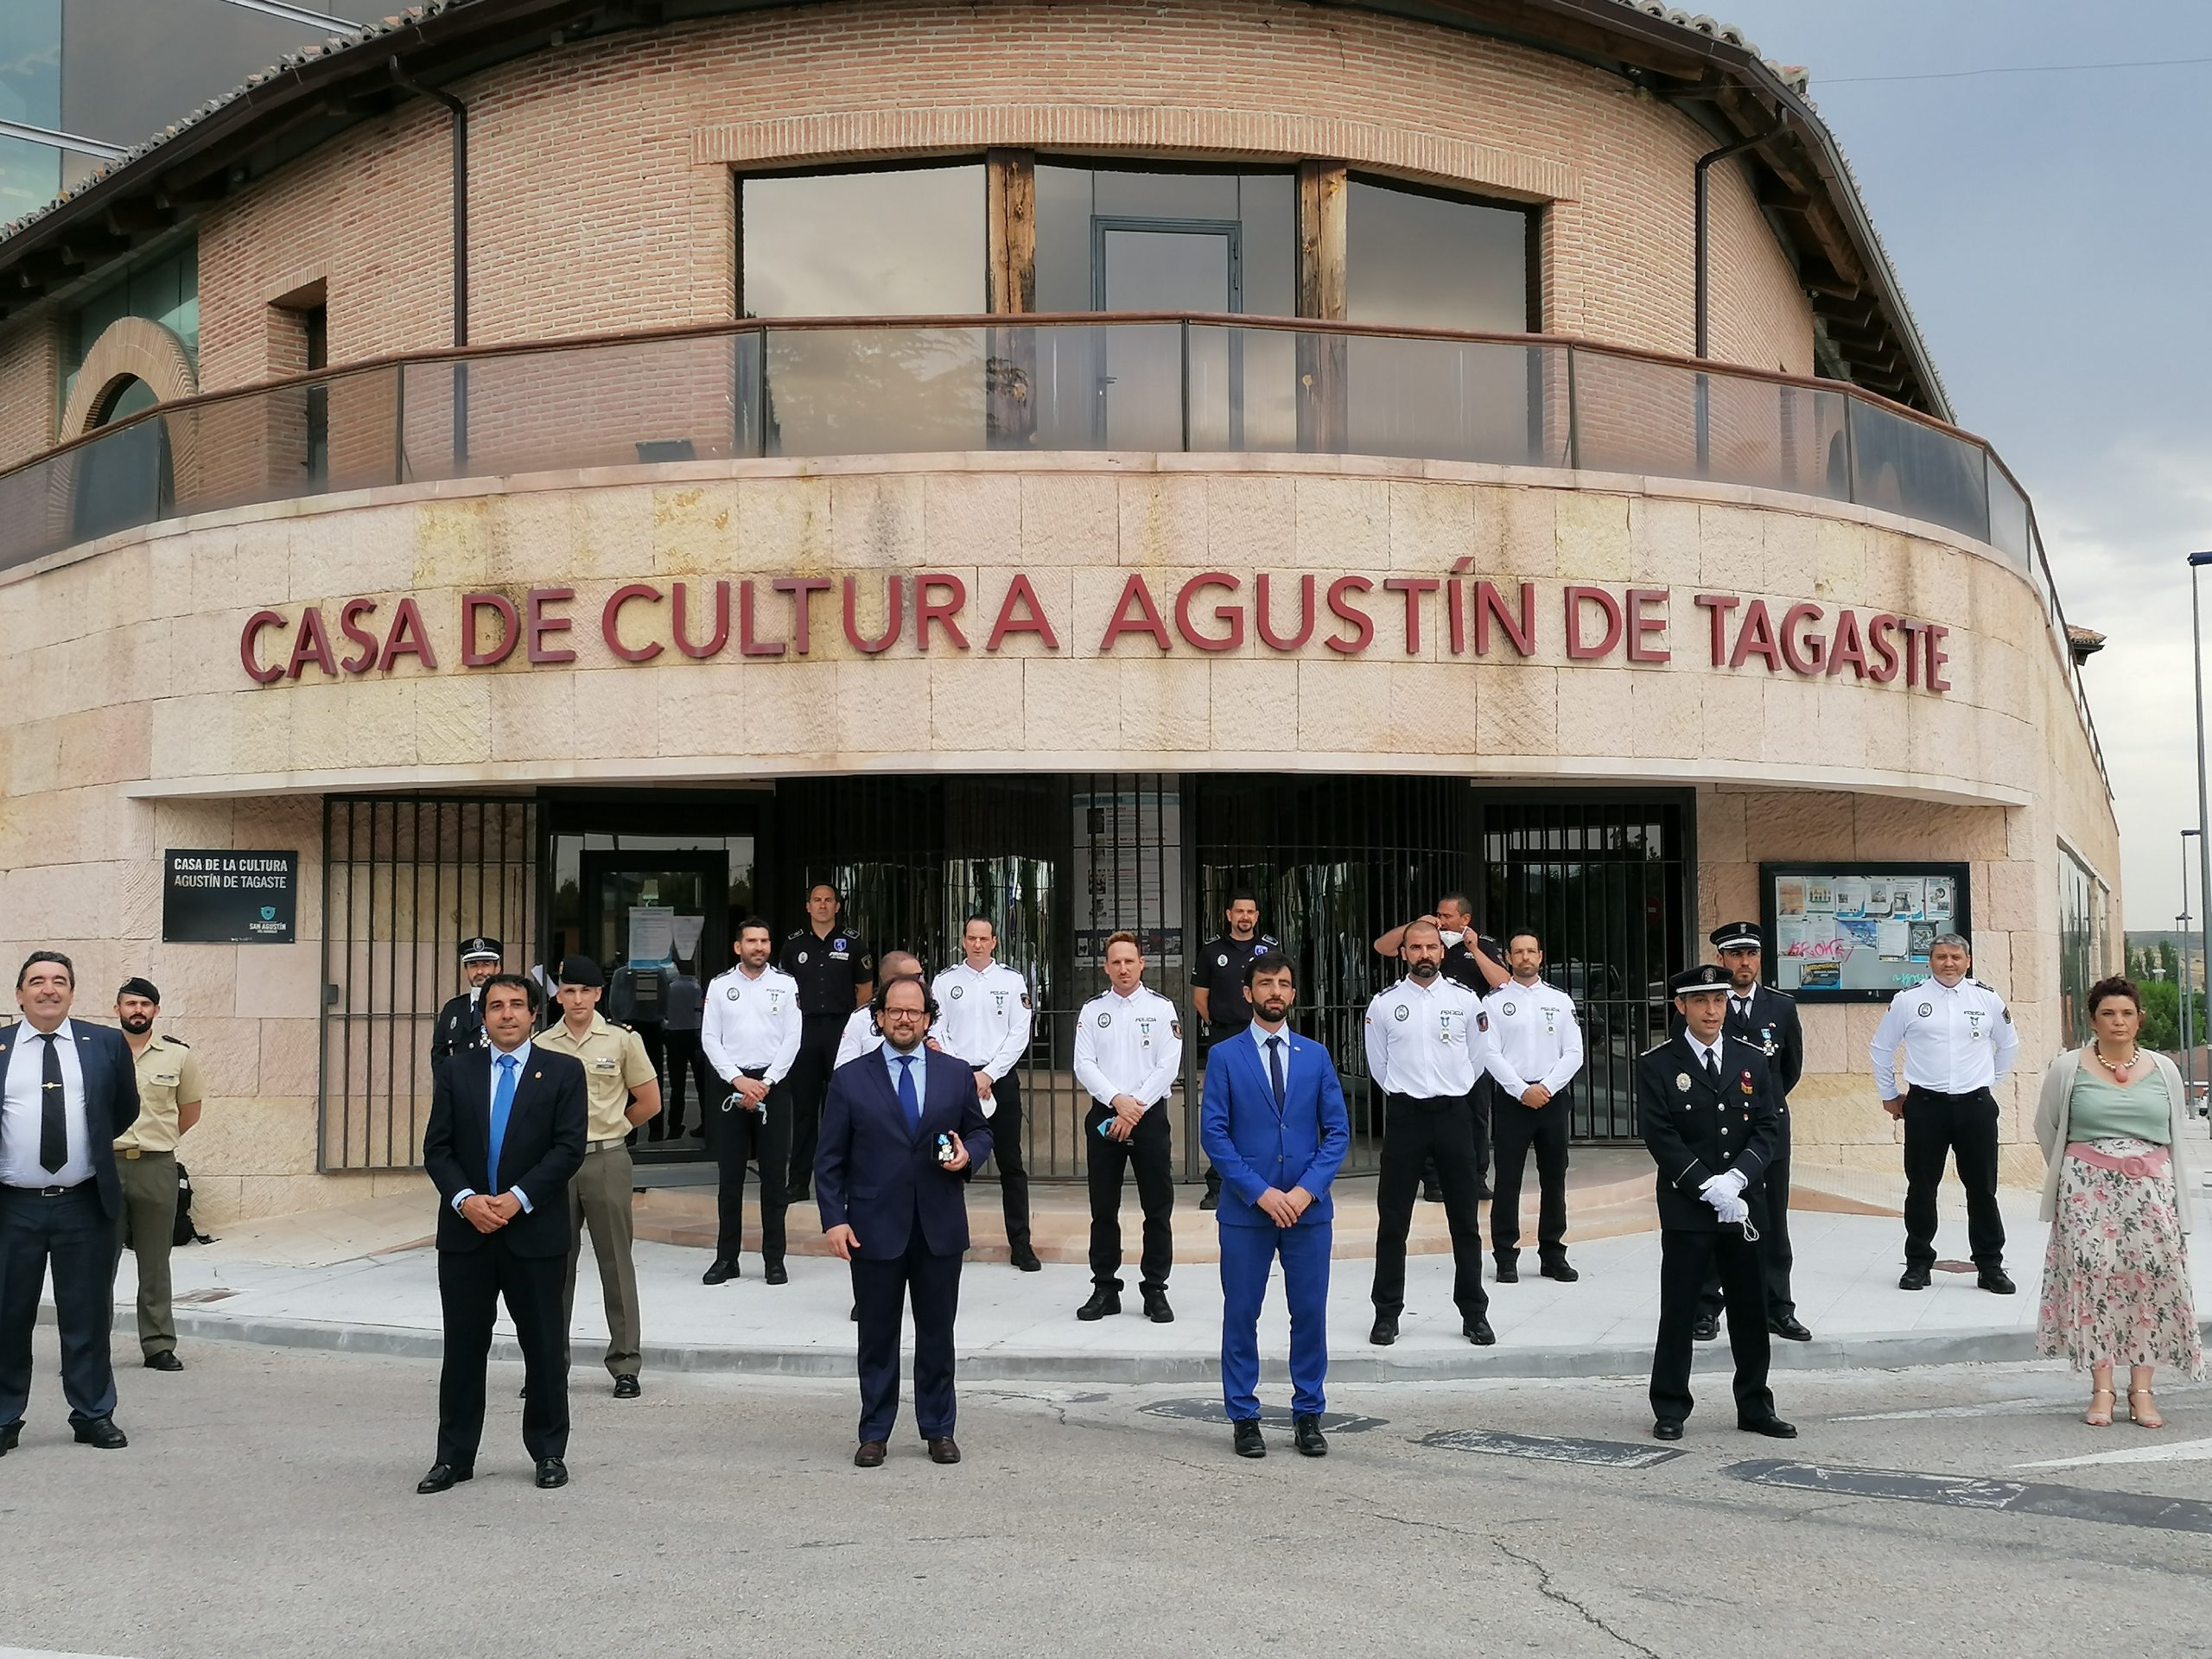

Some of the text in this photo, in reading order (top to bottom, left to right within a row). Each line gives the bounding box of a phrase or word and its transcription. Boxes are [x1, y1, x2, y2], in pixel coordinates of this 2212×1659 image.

[241, 556, 1950, 691] CASA DE CULTURA AGUSTÍN DE TAGASTE
[174, 858, 288, 872] CASA DE LA CULTURA
[174, 874, 287, 889] AGUSTÍN DE TAGASTE
